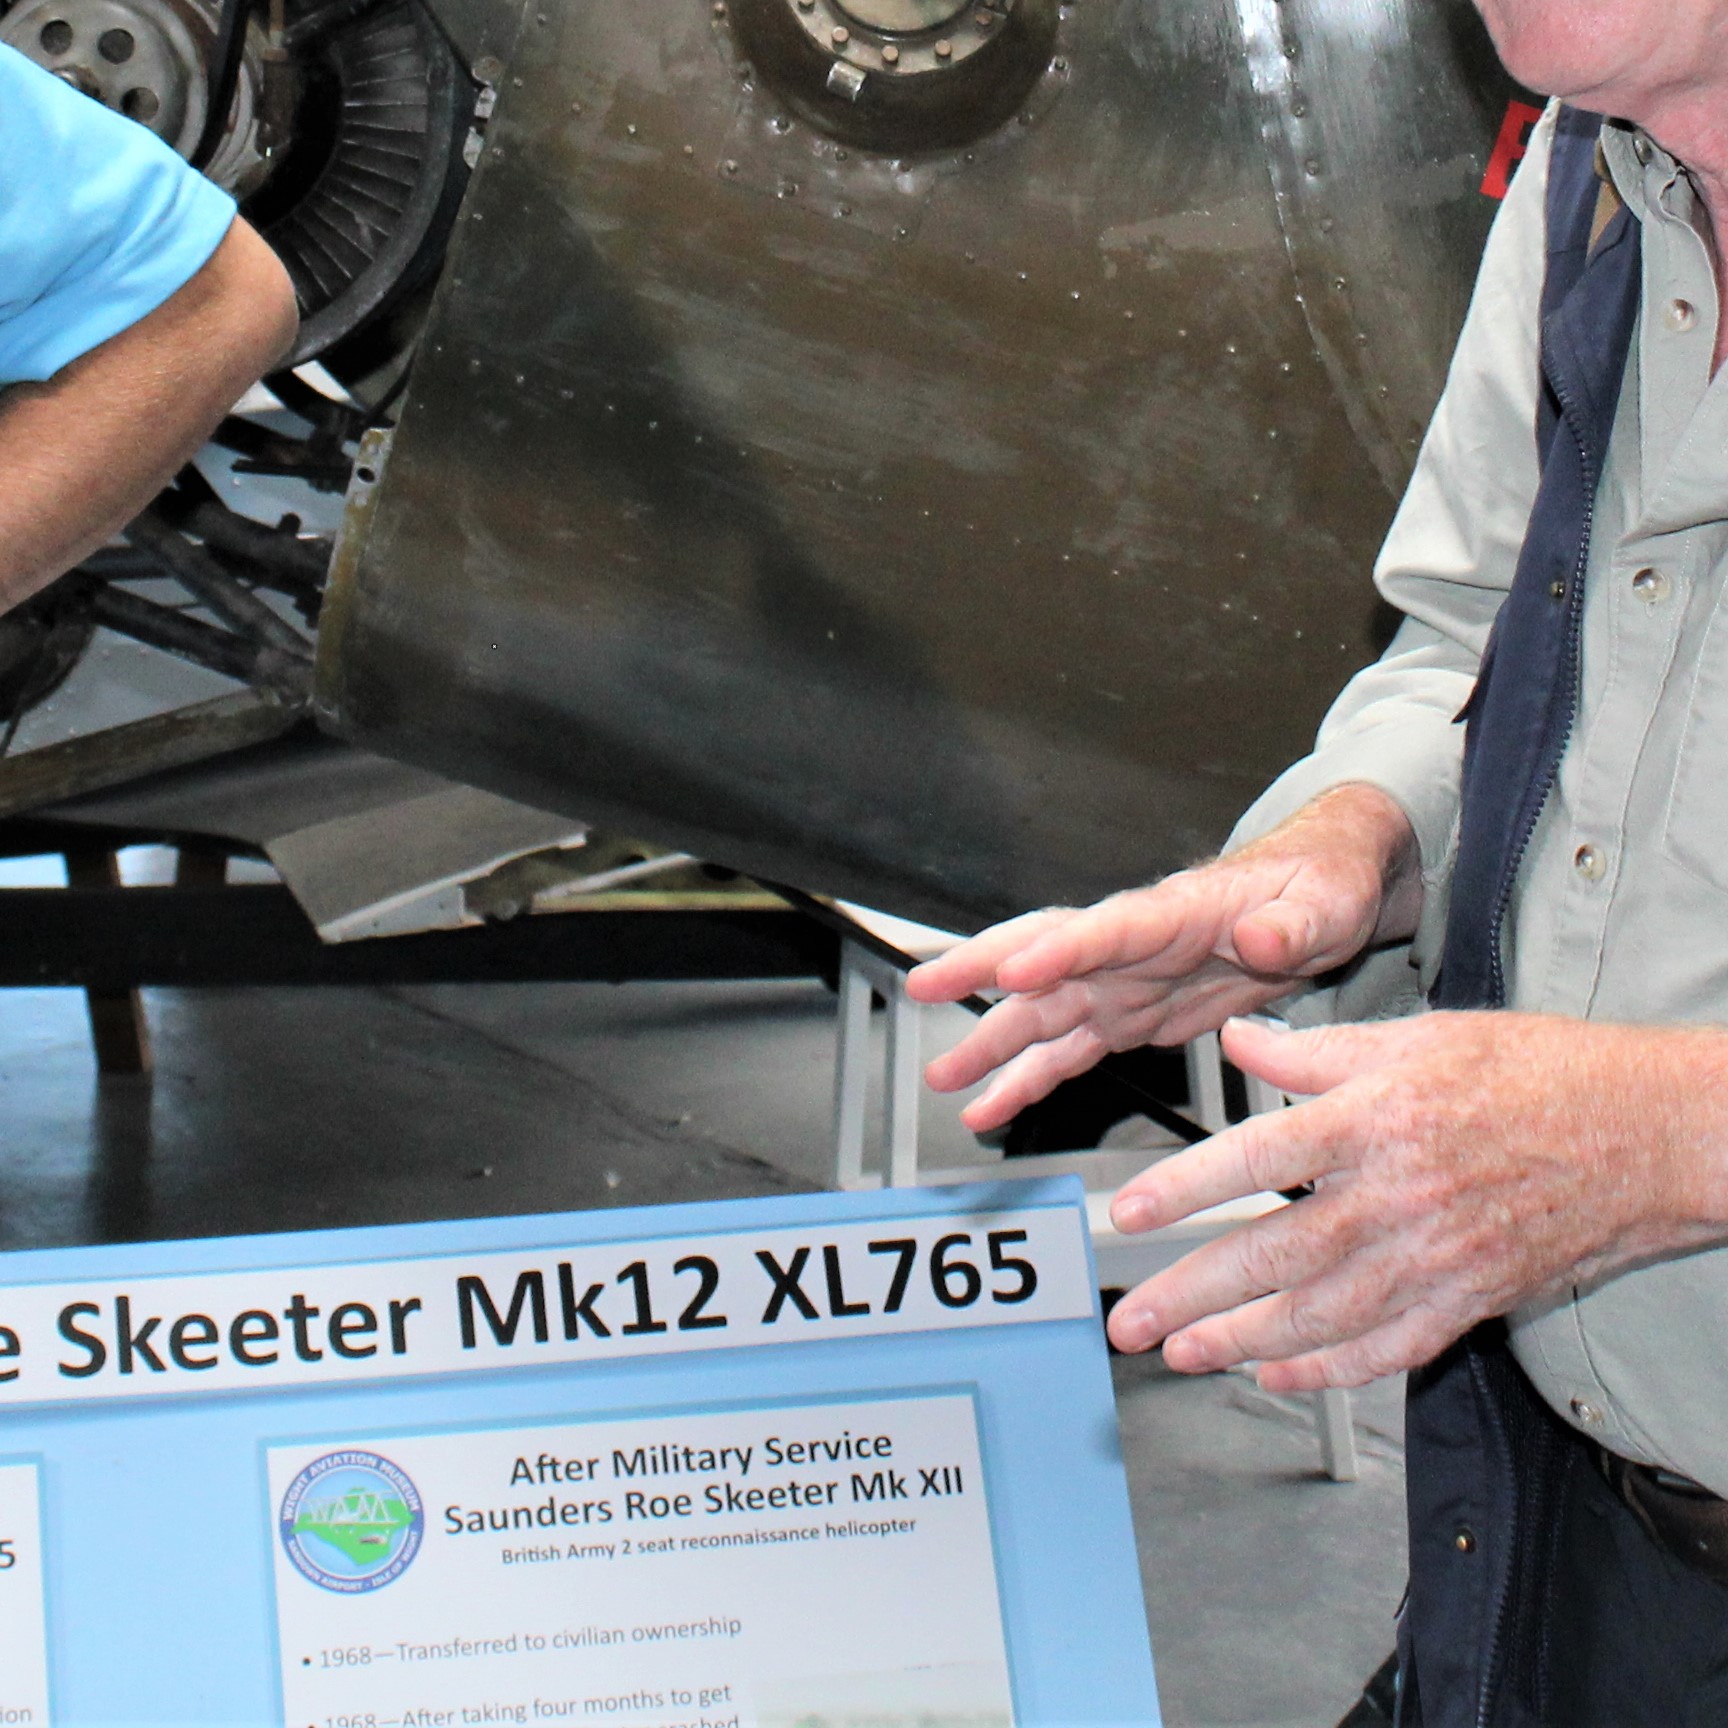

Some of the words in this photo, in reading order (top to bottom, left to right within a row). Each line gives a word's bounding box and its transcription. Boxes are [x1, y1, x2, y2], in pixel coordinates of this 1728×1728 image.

[57, 1294, 422, 1379] Skeeter
[456, 1262, 728, 1350] Mk12
[754, 1229, 1039, 1325] XL765
[510, 1453, 600, 1487] After
[613, 1444, 752, 1478] Military
[765, 1430, 893, 1466] Service
[282, 1475, 309, 1522] WIGHT
[309, 1454, 377, 1477] AVIATION
[380, 1462, 421, 1512] MUSEUM
[445, 1496, 613, 1535] Saunders
[626, 1491, 693, 1521] Roe
[704, 1480, 839, 1514] Skeeter
[851, 1469, 908, 1502] Mk
[919, 1465, 964, 1497] XII
[502, 1544, 561, 1565] British
[567, 1541, 615, 1560] Army
[622, 1539, 633, 1555] 2
[637, 1537, 675, 1554] seat
[681, 1527, 820, 1550] reconnaissance
[825, 1519, 917, 1540] helicopter
[525, 1631, 547, 1651] to
[552, 1625, 626, 1648] civilian
[631, 1616, 743, 1643] ownership
[462, 1699, 528, 1723] taking
[533, 1698, 575, 1719] four
[584, 1689, 664, 1714] months
[671, 1689, 692, 1705] to
[699, 1685, 733, 1708] get
